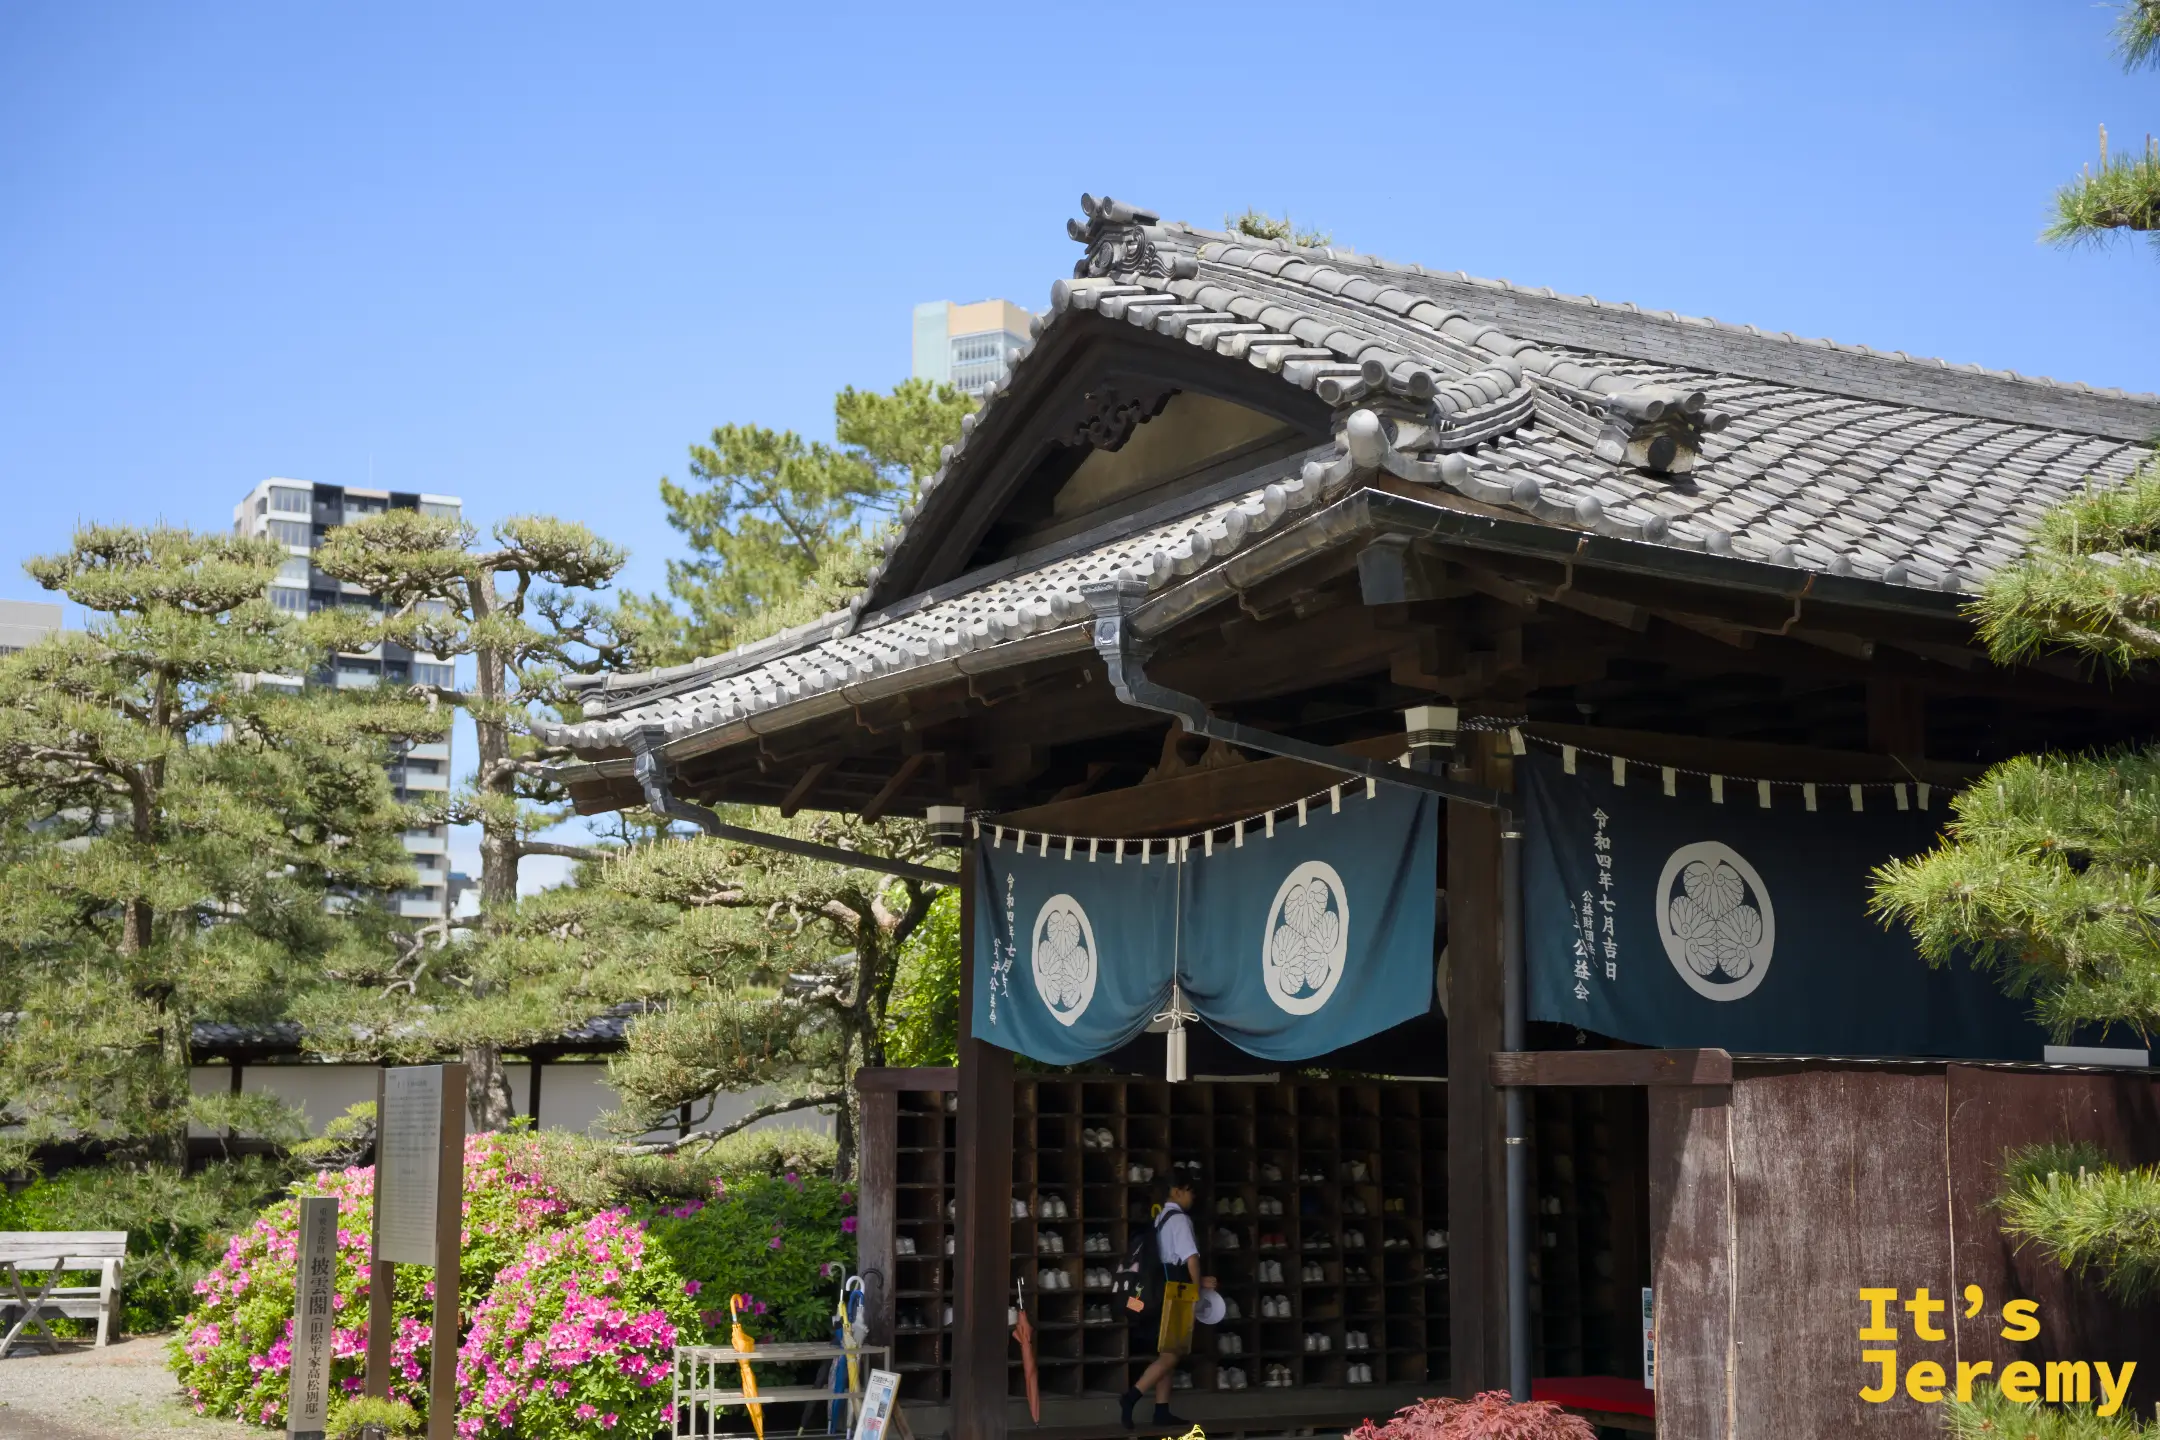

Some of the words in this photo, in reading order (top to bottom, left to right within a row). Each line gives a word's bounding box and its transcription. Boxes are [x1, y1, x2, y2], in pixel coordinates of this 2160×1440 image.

[1592, 807, 1617, 981] 令和四年七月吉日
